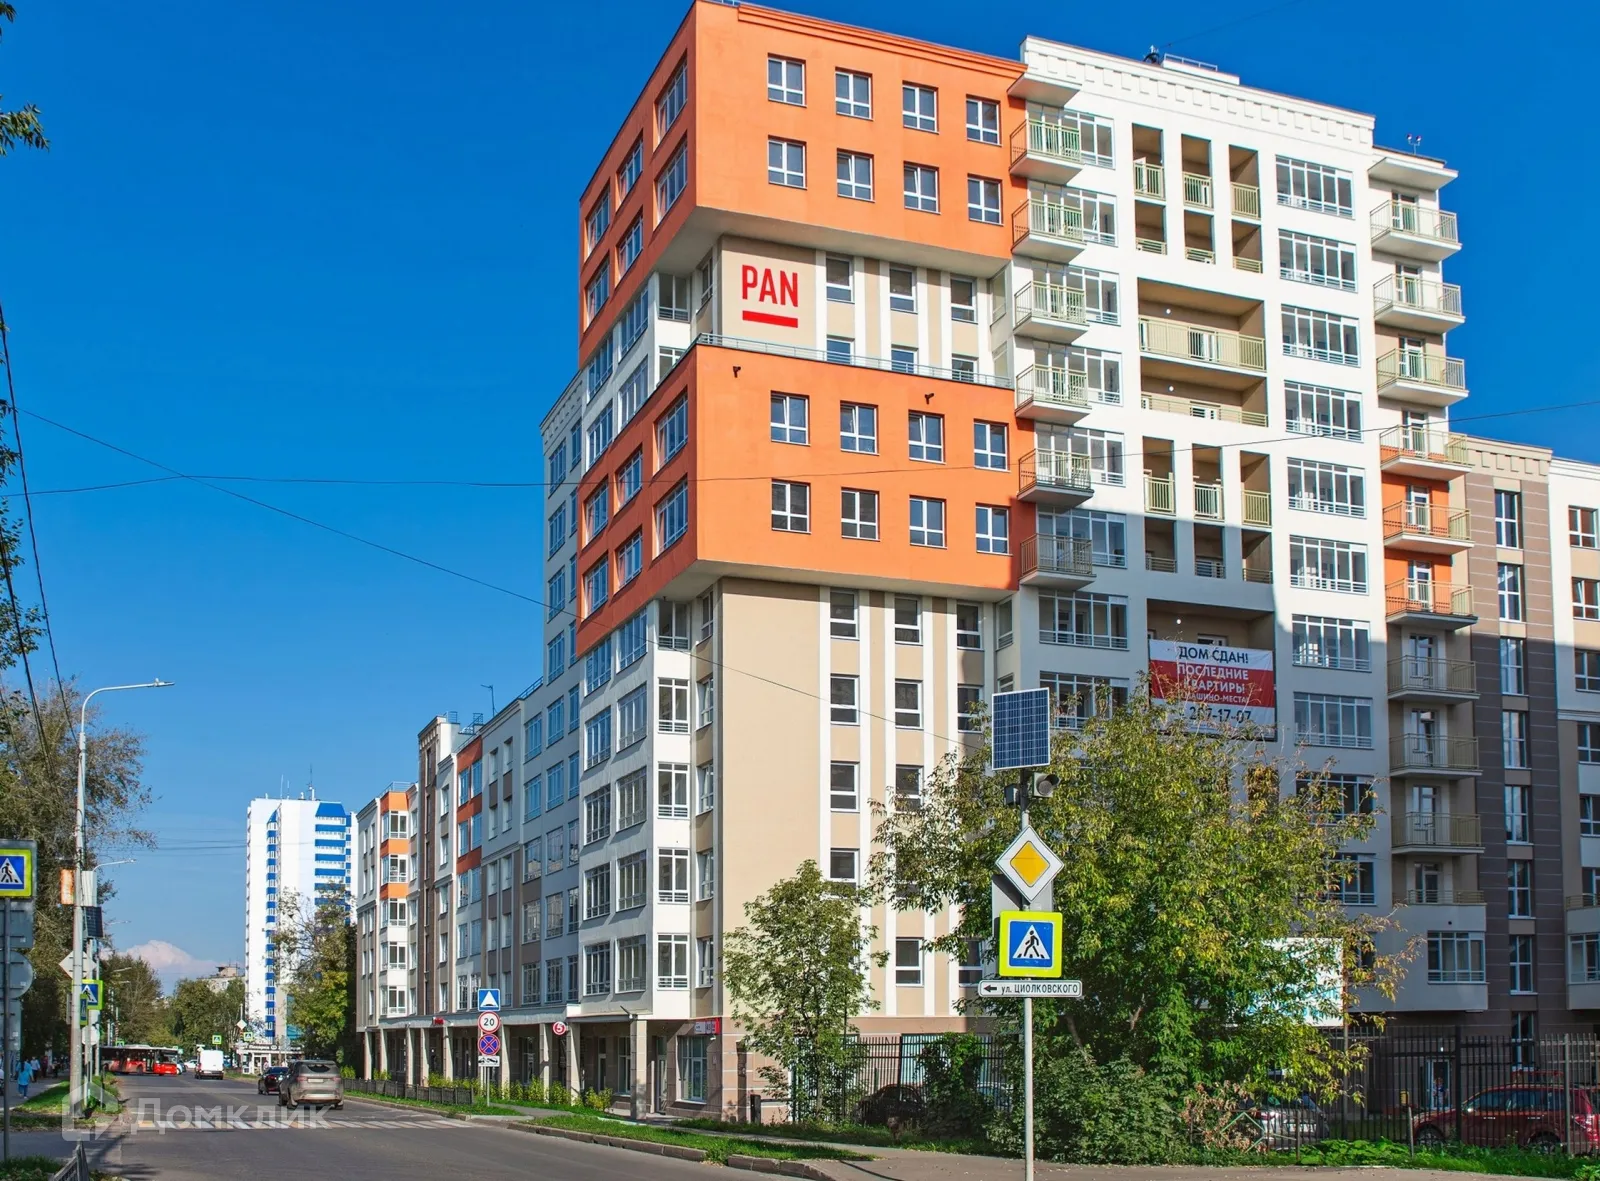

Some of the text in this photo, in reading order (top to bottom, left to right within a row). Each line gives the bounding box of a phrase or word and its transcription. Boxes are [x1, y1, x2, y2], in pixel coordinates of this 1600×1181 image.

[742, 265, 798, 307] PAN
[1178, 646, 1249, 664] ДОМ СДАН!
[1177, 664, 1249, 680] ПОСЛЕДНИЕ
[1001, 983, 1078, 995] ул. ЦИОЛКОВСКОГО
[483, 1017, 495, 1027] 20
